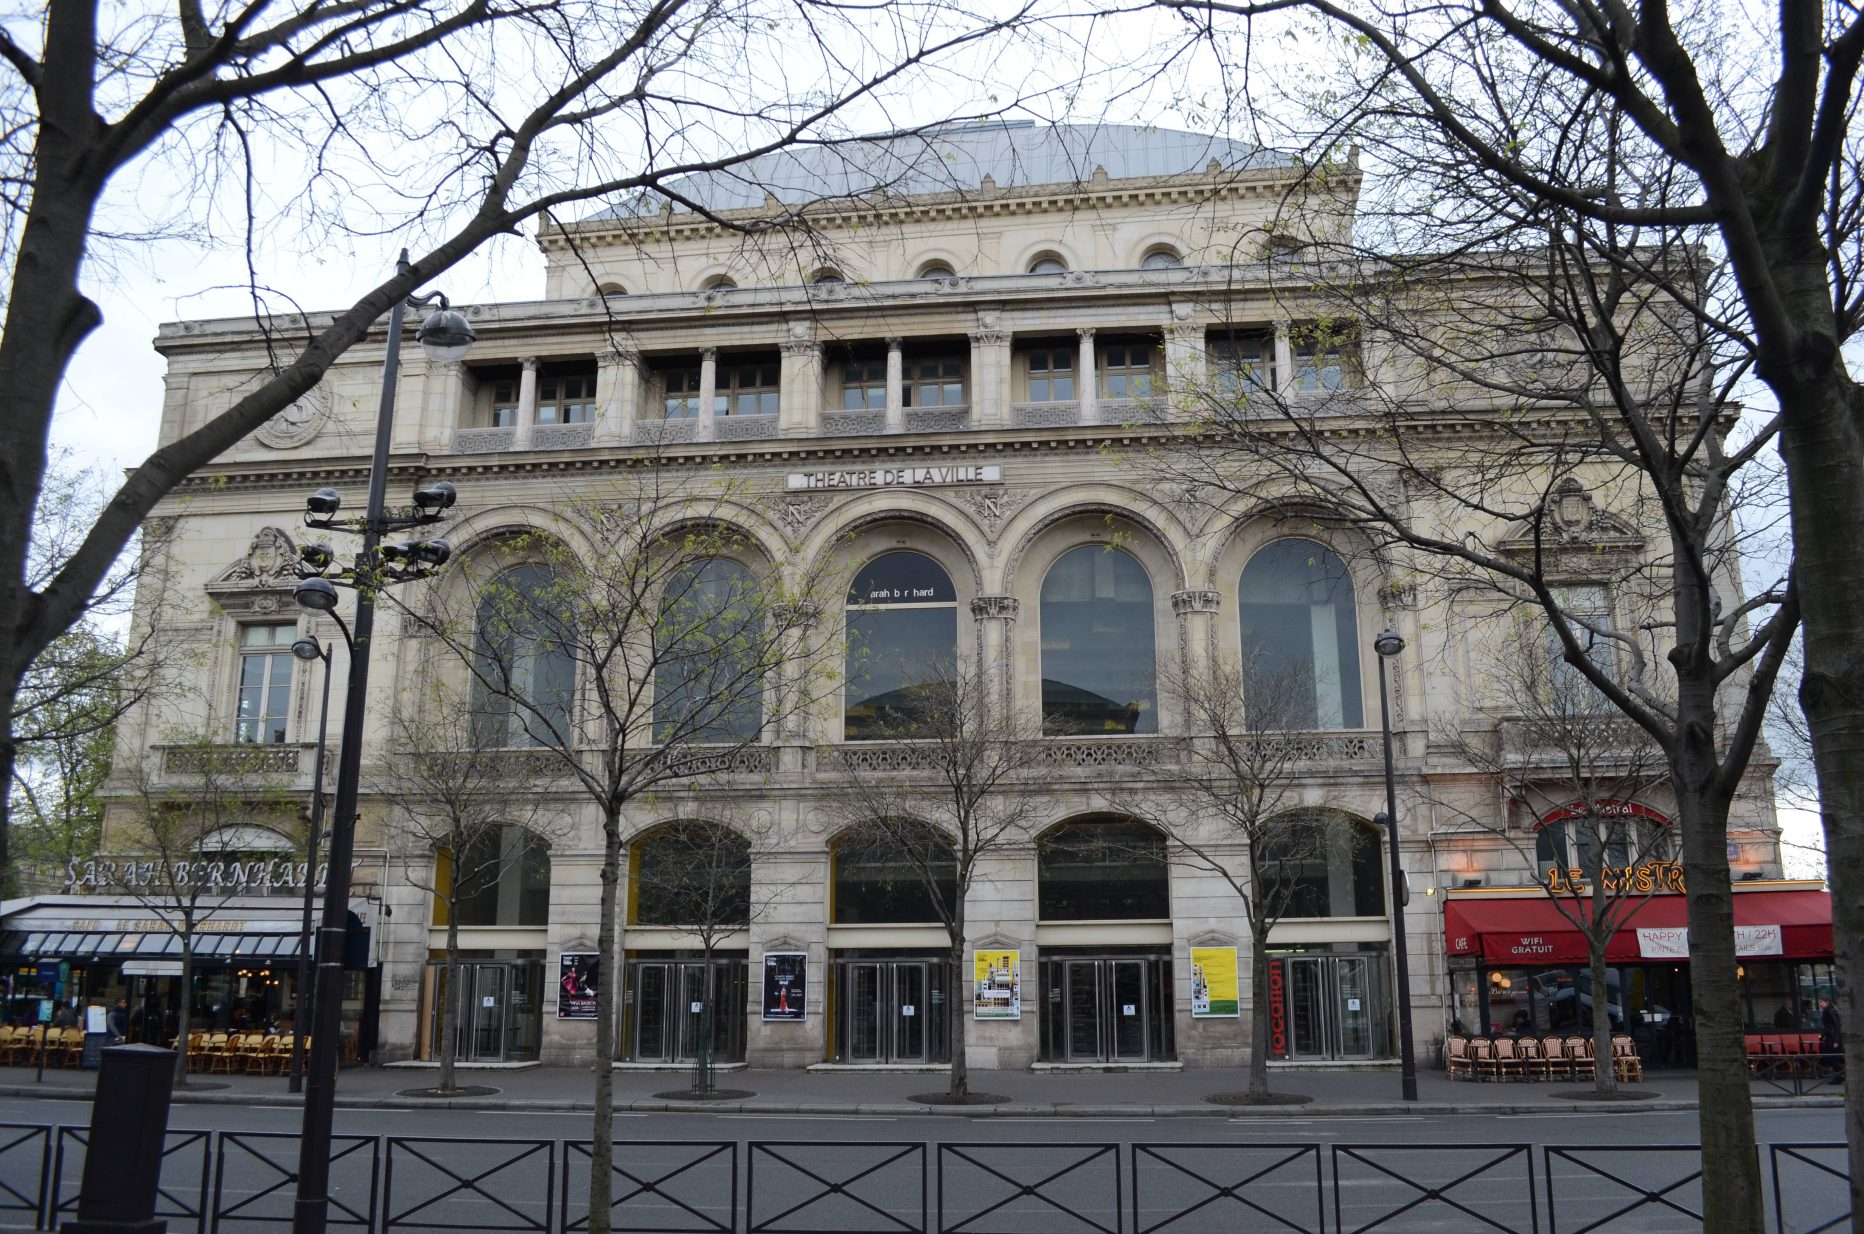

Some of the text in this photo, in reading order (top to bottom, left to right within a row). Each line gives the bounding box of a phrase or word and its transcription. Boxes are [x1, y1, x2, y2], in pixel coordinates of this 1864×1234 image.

[804, 465, 983, 489] THEATRE DE LA VILLE
[1521, 937, 1543, 945] WIFI
[1643, 931, 1682, 941] HAPPY
[1755, 929, 1776, 939] 22H
[1512, 945, 1554, 954] GRATUIT
[1269, 960, 1286, 1055] location
